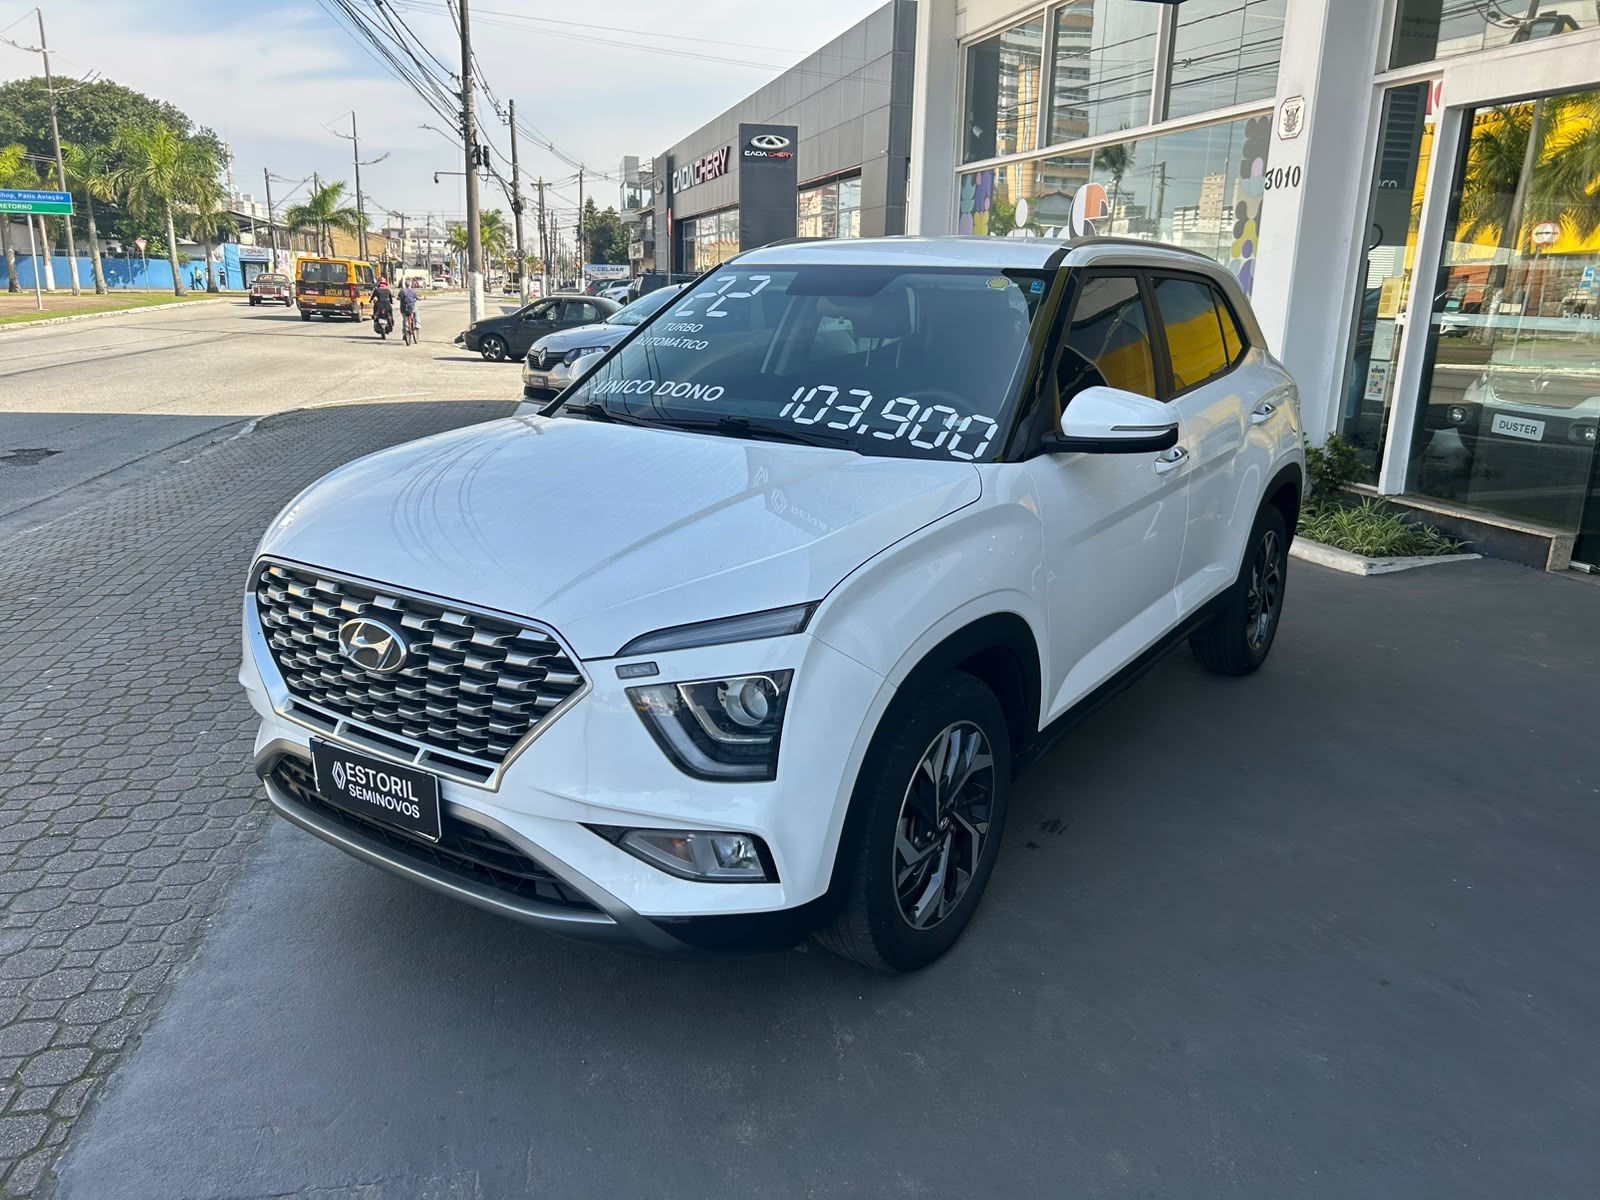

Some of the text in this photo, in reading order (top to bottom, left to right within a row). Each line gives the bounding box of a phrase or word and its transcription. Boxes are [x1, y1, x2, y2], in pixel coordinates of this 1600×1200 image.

[694, 145, 729, 185] CHERY
[1264, 165, 1301, 190] 3010
[0, 192, 16, 200] hop,
[37, 193, 64, 201] Aviação
[675, 275, 770, 317] 22
[662, 322, 704, 333] TURBO
[634, 335, 709, 351] AUTOMÁTICO
[593, 377, 725, 401] ÚNICO DONO
[779, 384, 999, 461] 103.900
[1499, 420, 1538, 435] DUSTER
[345, 762, 419, 802] ESTORIL
[348, 783, 420, 819] SEMINOVOS
